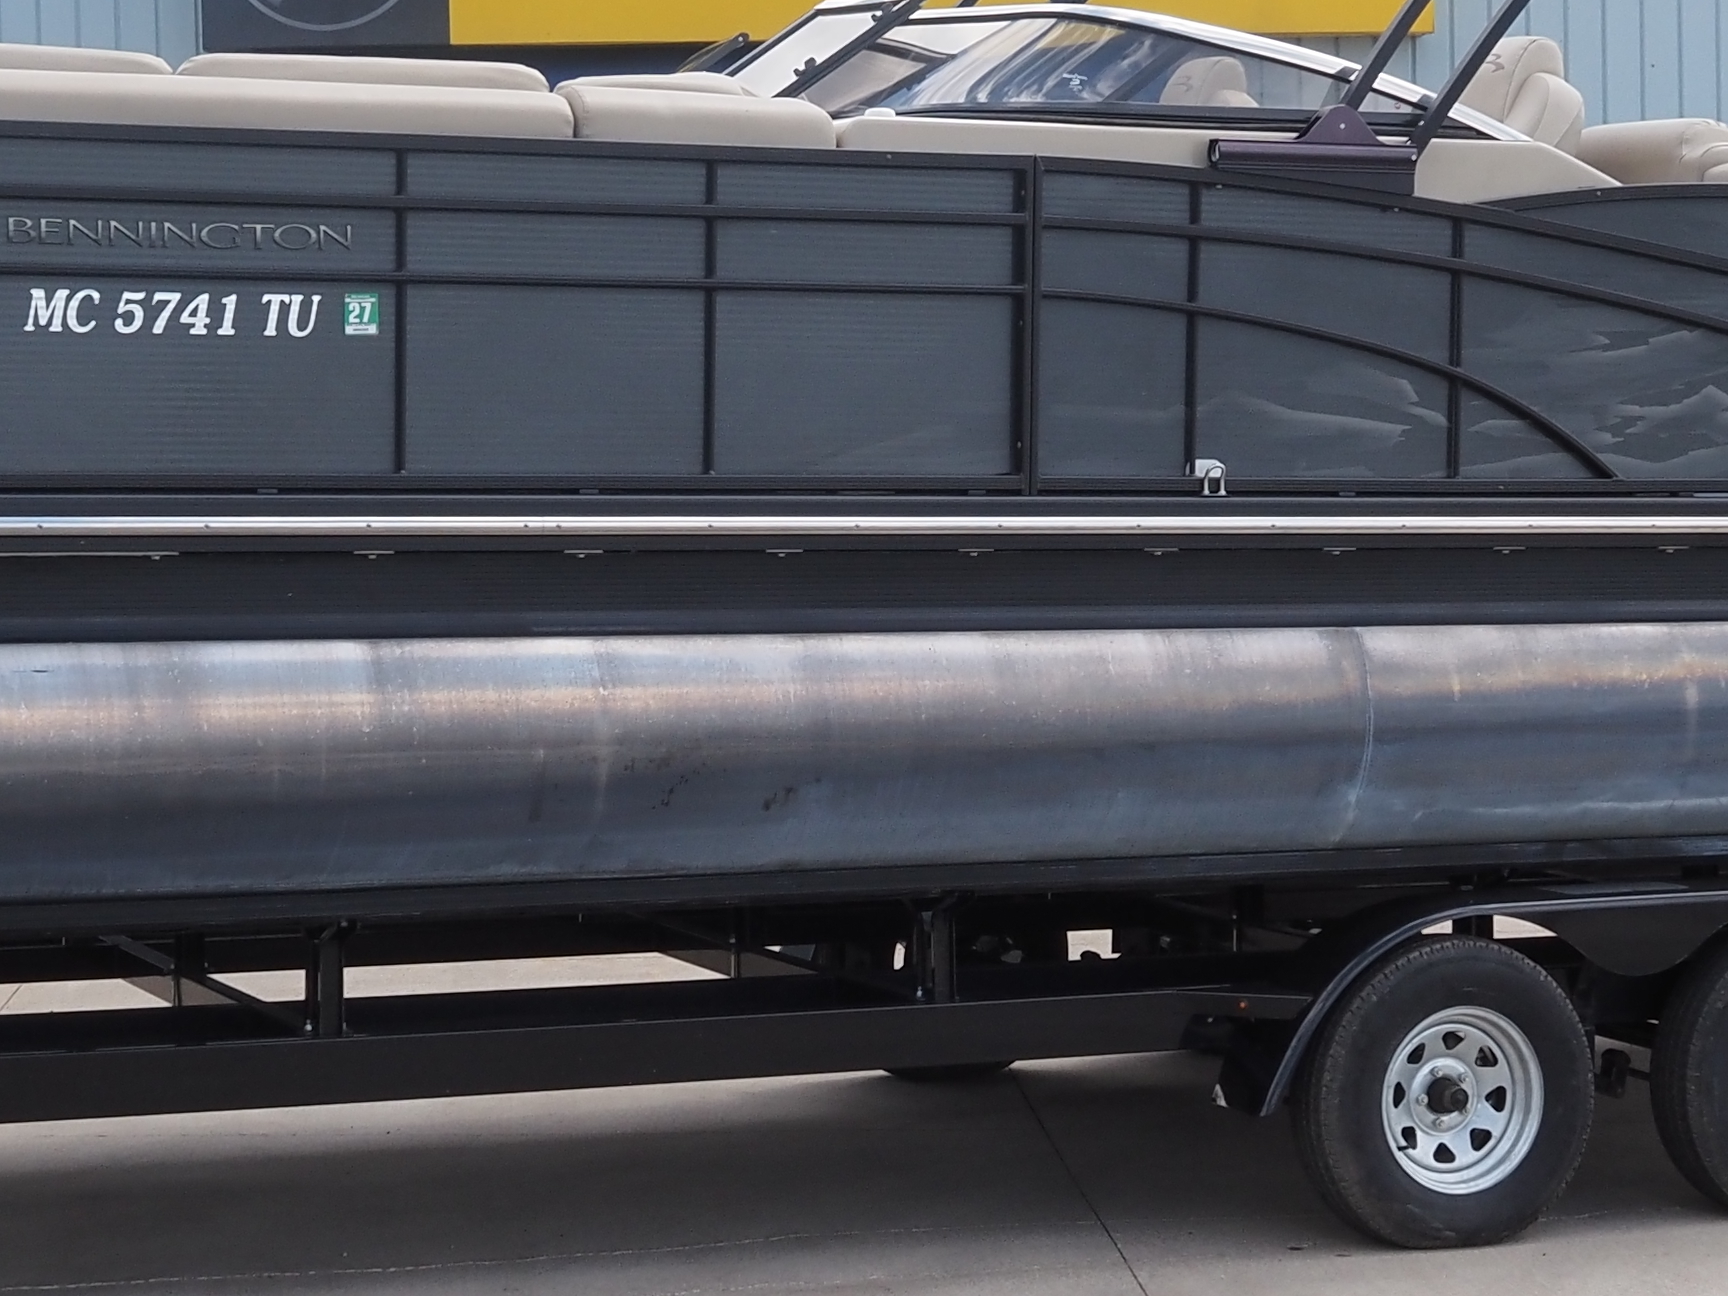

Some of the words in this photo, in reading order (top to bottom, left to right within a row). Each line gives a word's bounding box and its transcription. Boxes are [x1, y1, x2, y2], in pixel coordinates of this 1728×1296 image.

[7, 216, 352, 251] BENNINGTON
[23, 288, 101, 334] MC
[113, 290, 238, 336] 5741
[261, 292, 322, 338] TU
[348, 302, 372, 324] 27
